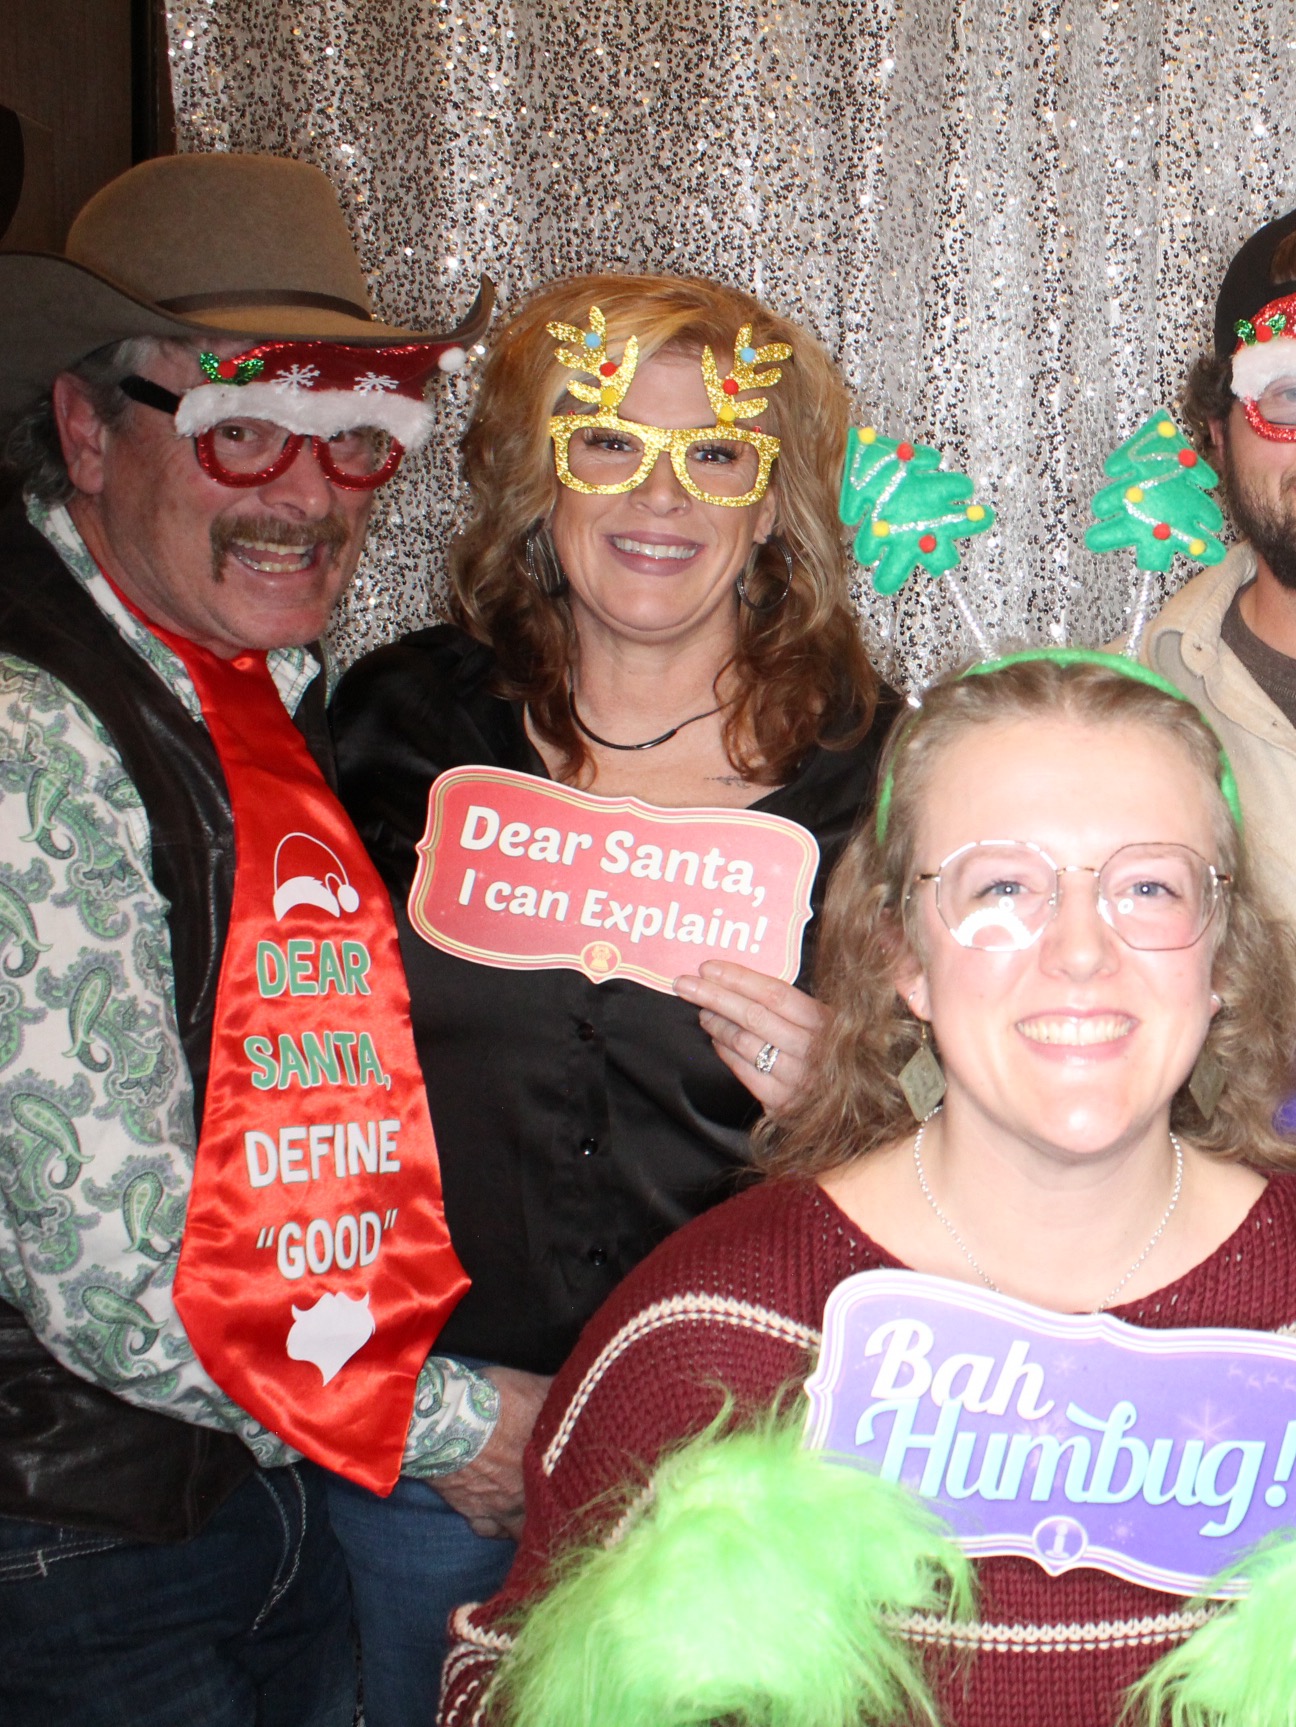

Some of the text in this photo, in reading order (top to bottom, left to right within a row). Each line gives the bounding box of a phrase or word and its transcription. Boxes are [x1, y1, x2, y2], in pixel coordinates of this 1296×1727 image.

[459, 805, 766, 907] Dear Santa,
[458, 868, 768, 954] I can Explain!
[255, 939, 371, 999] DEAR
[243, 1031, 392, 1091] SANTA,
[244, 1119, 401, 1189] DEFINE
[864, 1318, 1055, 1420] Bah
